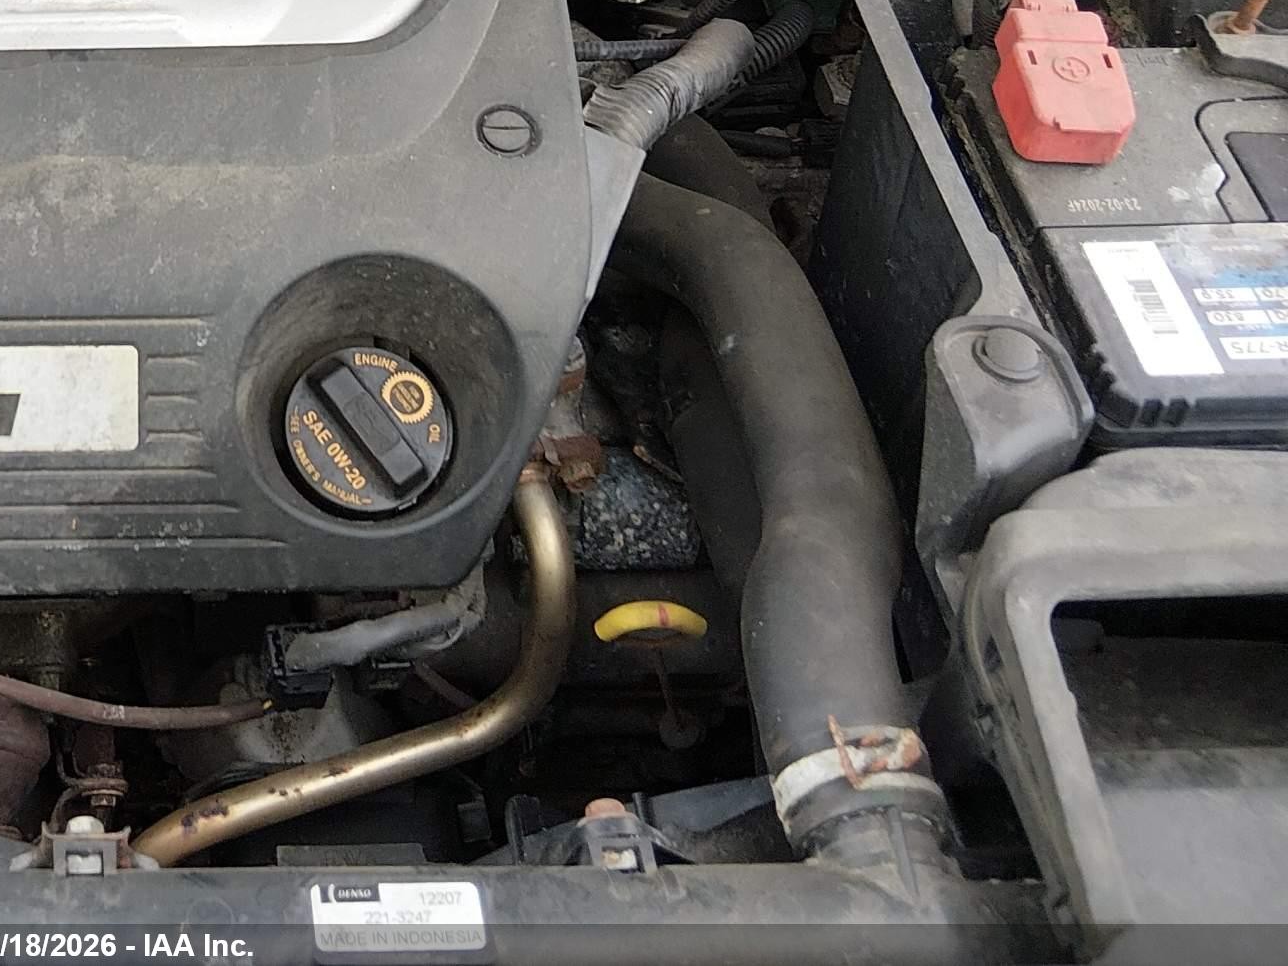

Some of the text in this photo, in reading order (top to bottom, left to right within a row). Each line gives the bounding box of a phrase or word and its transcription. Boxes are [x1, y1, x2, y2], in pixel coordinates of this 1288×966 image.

[354, 353, 399, 372] ENGINE
[428, 424, 441, 443] OIL
[303, 410, 367, 490] SAE 0W-20
[337, 888, 463, 906] DENSO 12207
[365, 910, 432, 924] 221-3247
[320, 930, 482, 946] MADE IN INDONESIA
